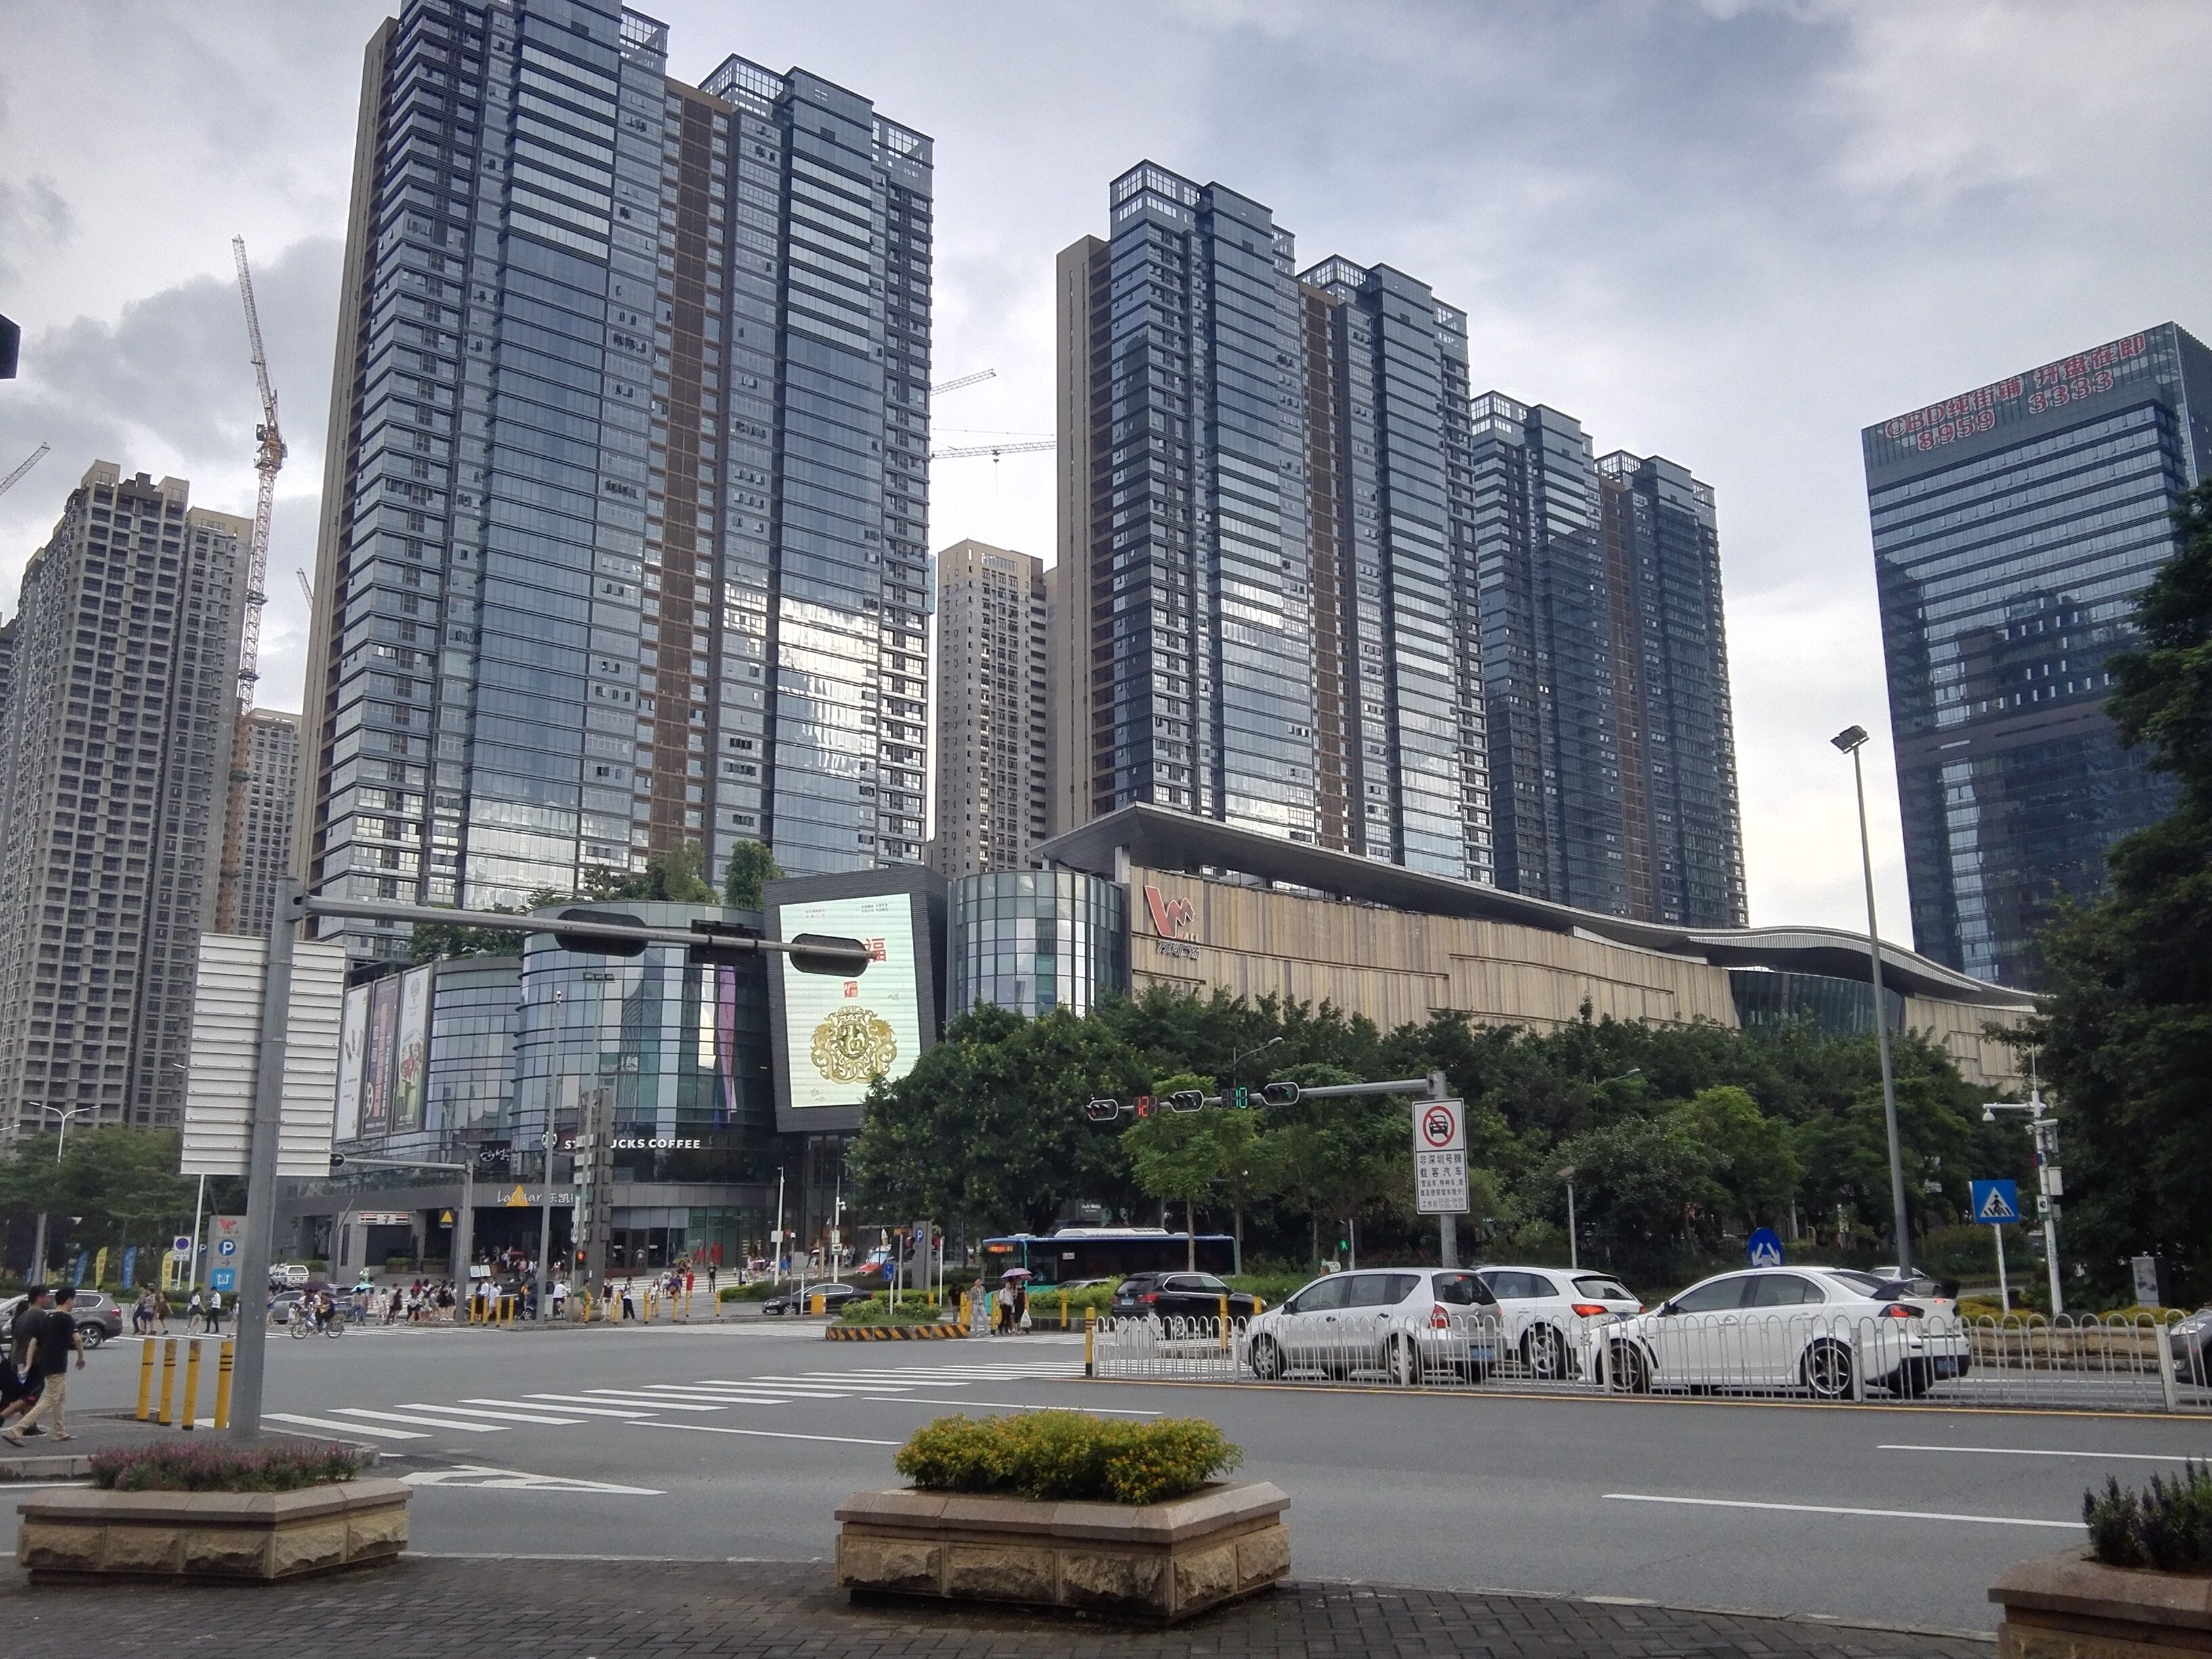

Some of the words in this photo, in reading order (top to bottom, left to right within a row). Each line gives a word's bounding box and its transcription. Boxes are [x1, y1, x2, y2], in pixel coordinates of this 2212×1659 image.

[2033, 333, 2147, 389] 开盘在即
[1917, 408, 1995, 451] 8959
[2028, 369, 2114, 414] 3333
[1156, 940, 1200, 960] 万科广场
[648, 1139, 701, 1149] COFFEE
[1420, 1153, 1462, 1165] 非深圳号牌
[1420, 1166, 1463, 1178] 载客汽车
[222, 1242, 234, 1254] P
